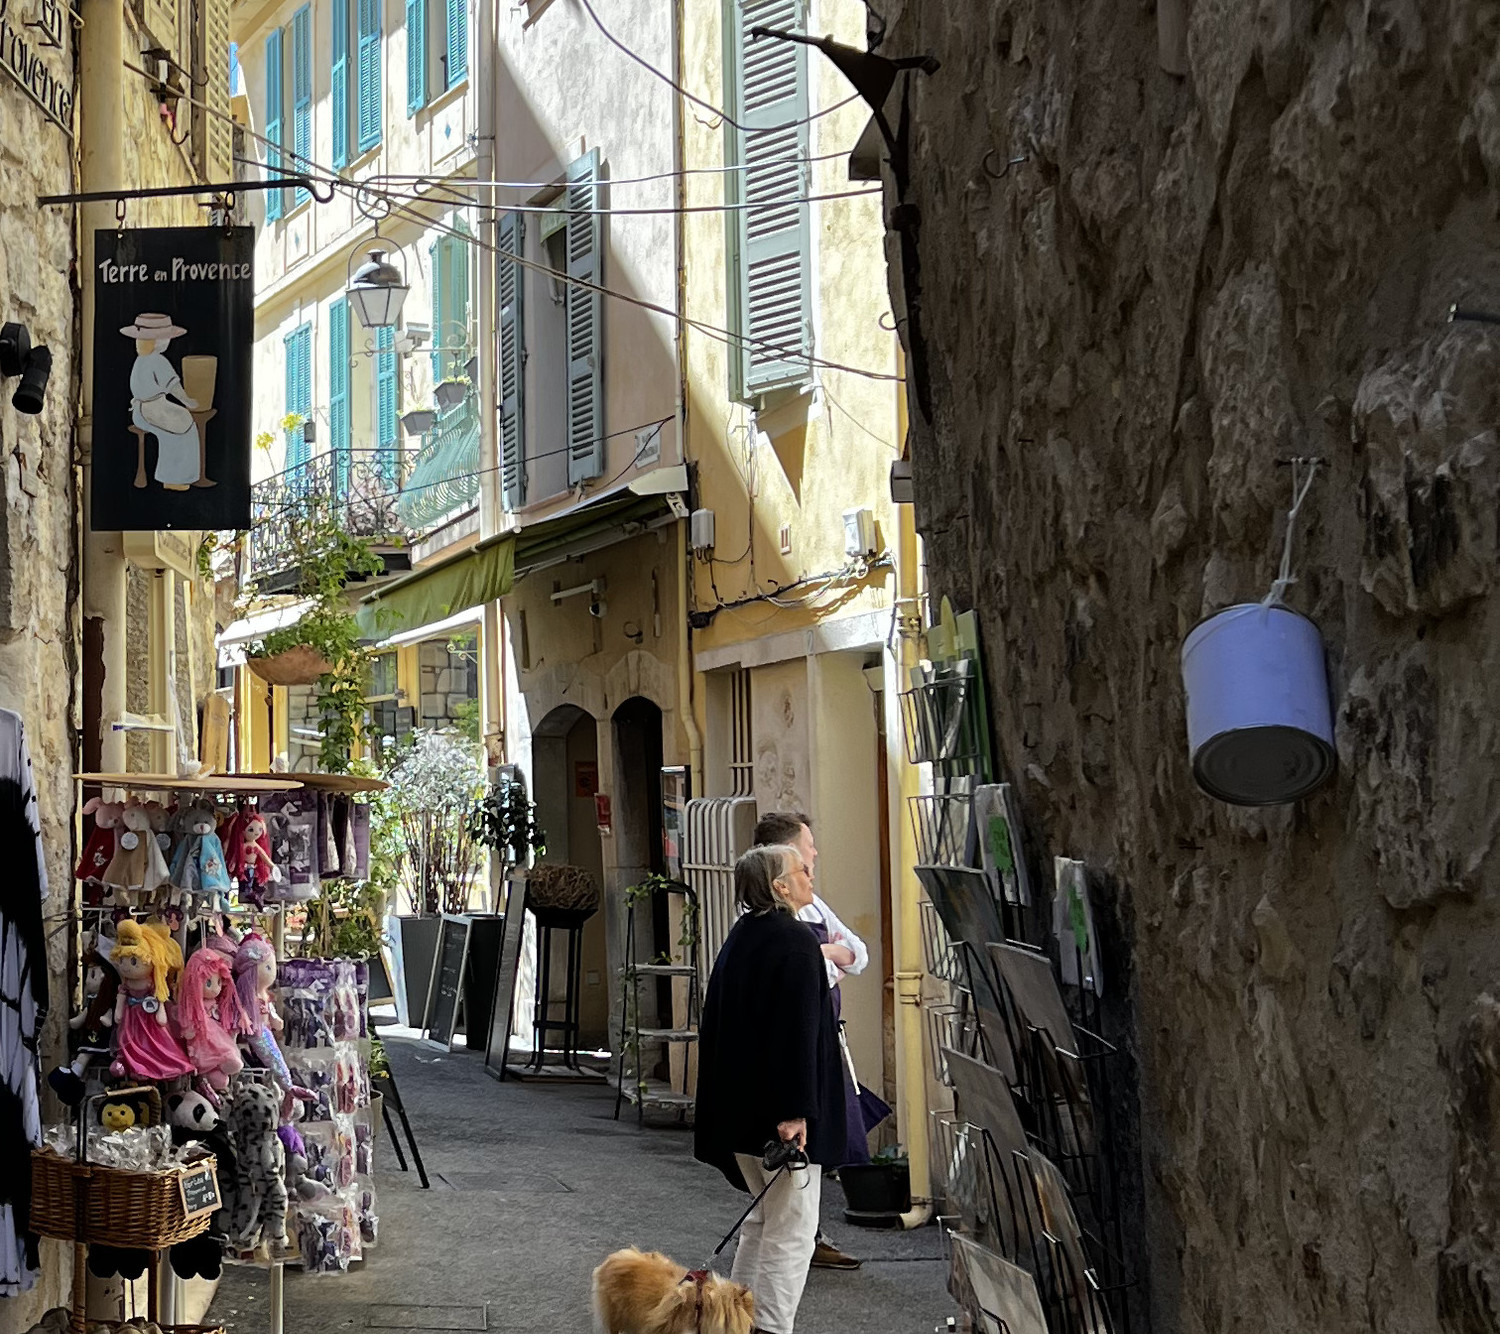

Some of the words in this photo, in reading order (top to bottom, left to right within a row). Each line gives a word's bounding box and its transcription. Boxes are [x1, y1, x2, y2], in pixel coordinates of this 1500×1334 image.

[98, 258, 149, 283] Terre
[154, 269, 168, 282] en
[171, 257, 252, 282] Provence
